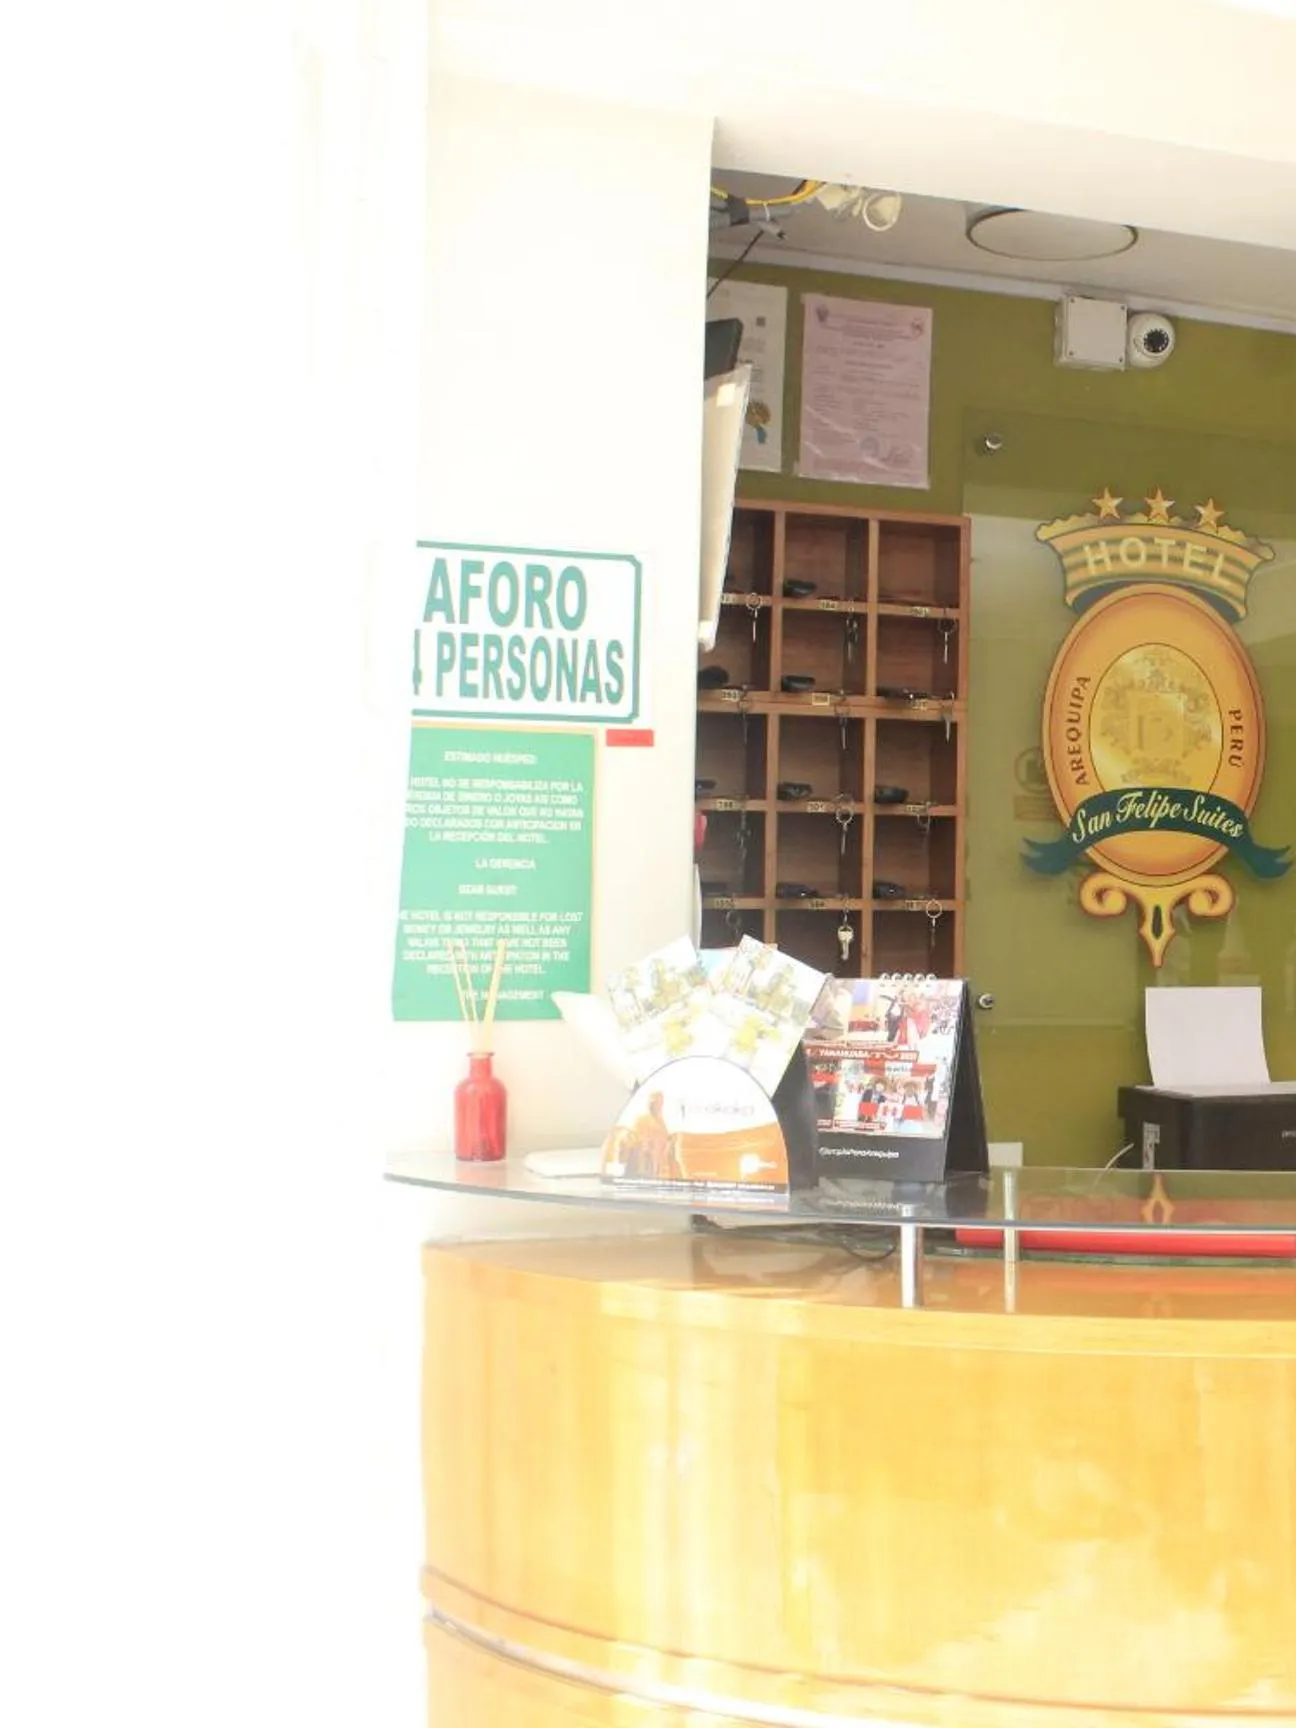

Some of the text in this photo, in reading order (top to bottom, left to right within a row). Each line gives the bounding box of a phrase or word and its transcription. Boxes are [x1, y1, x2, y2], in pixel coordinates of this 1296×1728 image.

[423, 557, 587, 631] AFORO
[1083, 536, 1228, 584] HOTEL
[436, 631, 625, 705] PERSONAS
[1066, 676, 1091, 786] AREQUIPA
[1072, 789, 1244, 844] San Felipe Suites
